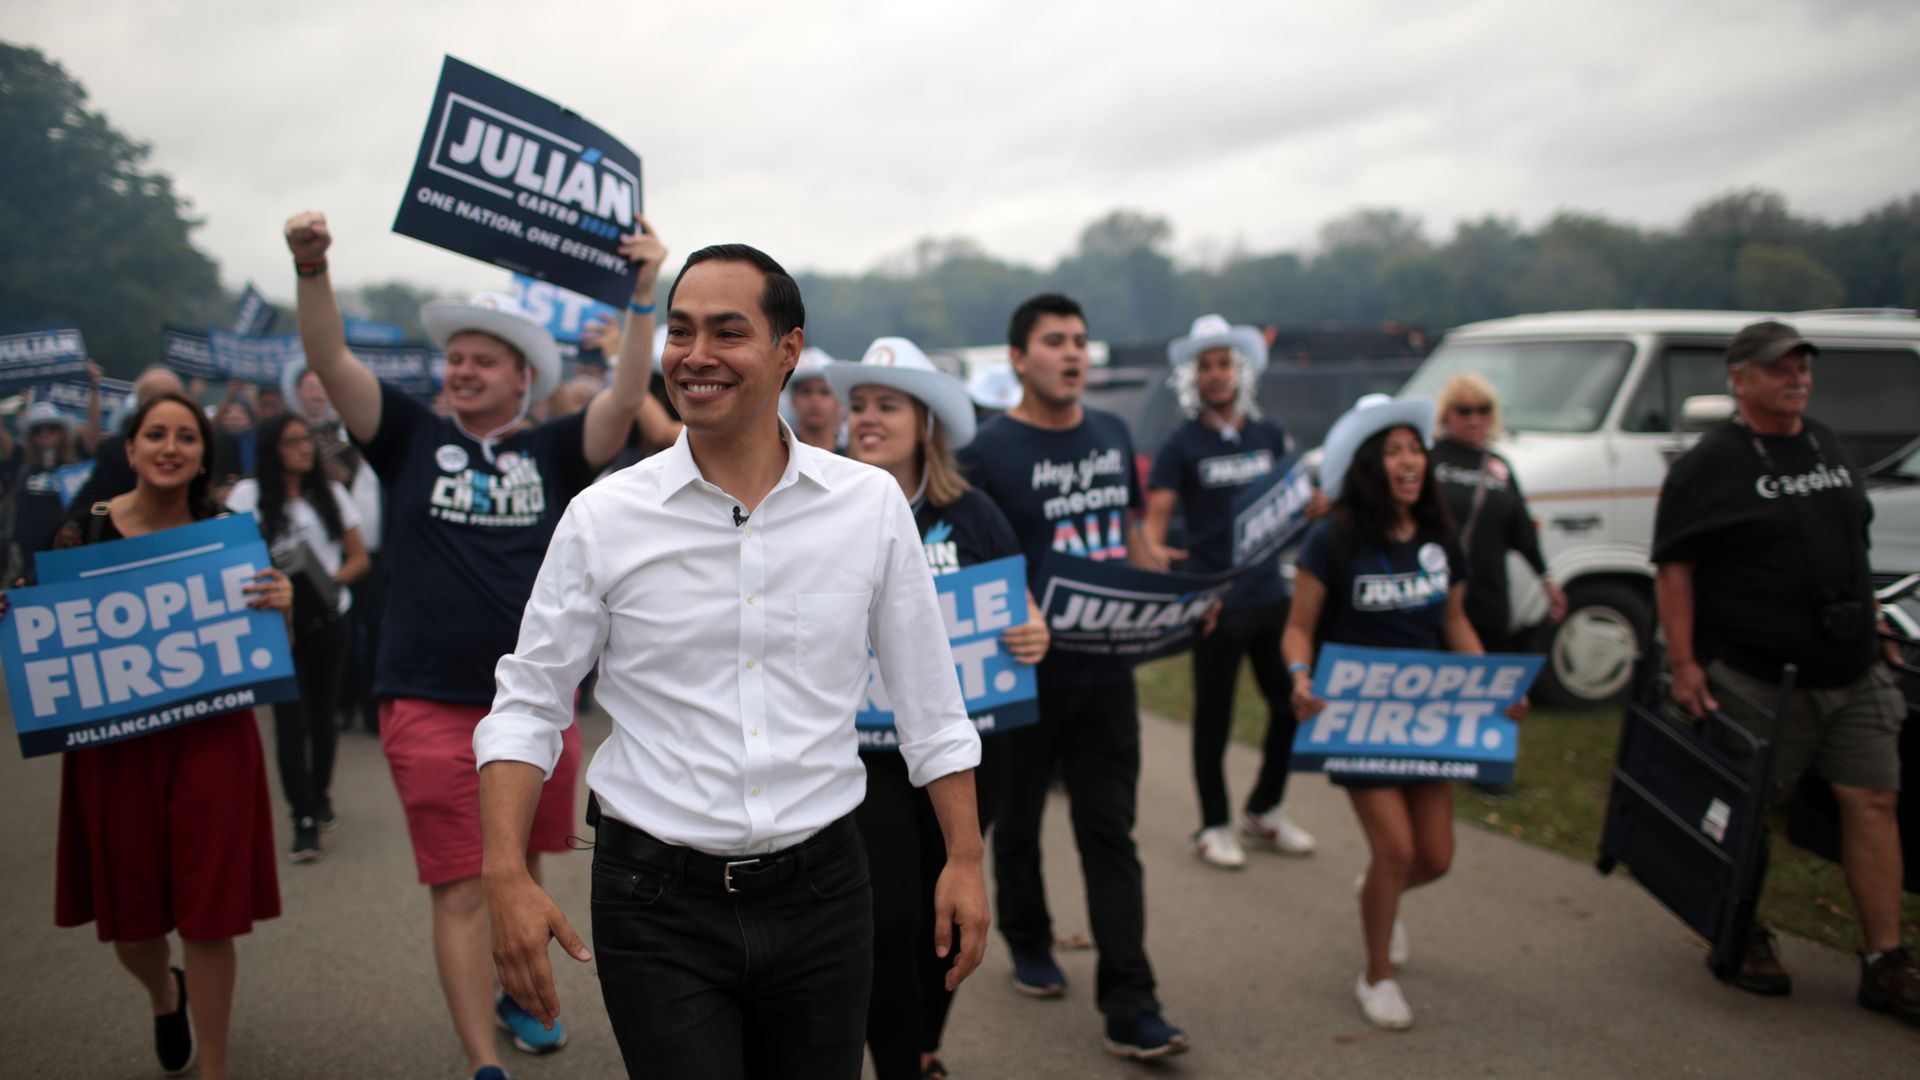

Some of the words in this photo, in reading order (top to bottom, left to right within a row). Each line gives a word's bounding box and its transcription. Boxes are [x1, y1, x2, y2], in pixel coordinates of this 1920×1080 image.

[449, 117, 634, 228] JULIÁN
[417, 187, 456, 213] ONE
[455, 200, 525, 238] NATION.
[526, 226, 561, 251] ONE
[560, 238, 629, 276] DESTINY.
[517, 191, 579, 226] CASTRO
[1043, 485, 1129, 520] means
[1051, 510, 1127, 562] ALL
[13, 562, 256, 654] PEOPLE
[24, 617, 272, 718] FIRST.
[1326, 660, 1526, 699] PEOPLE
[1310, 701, 1502, 750] FIRST.
